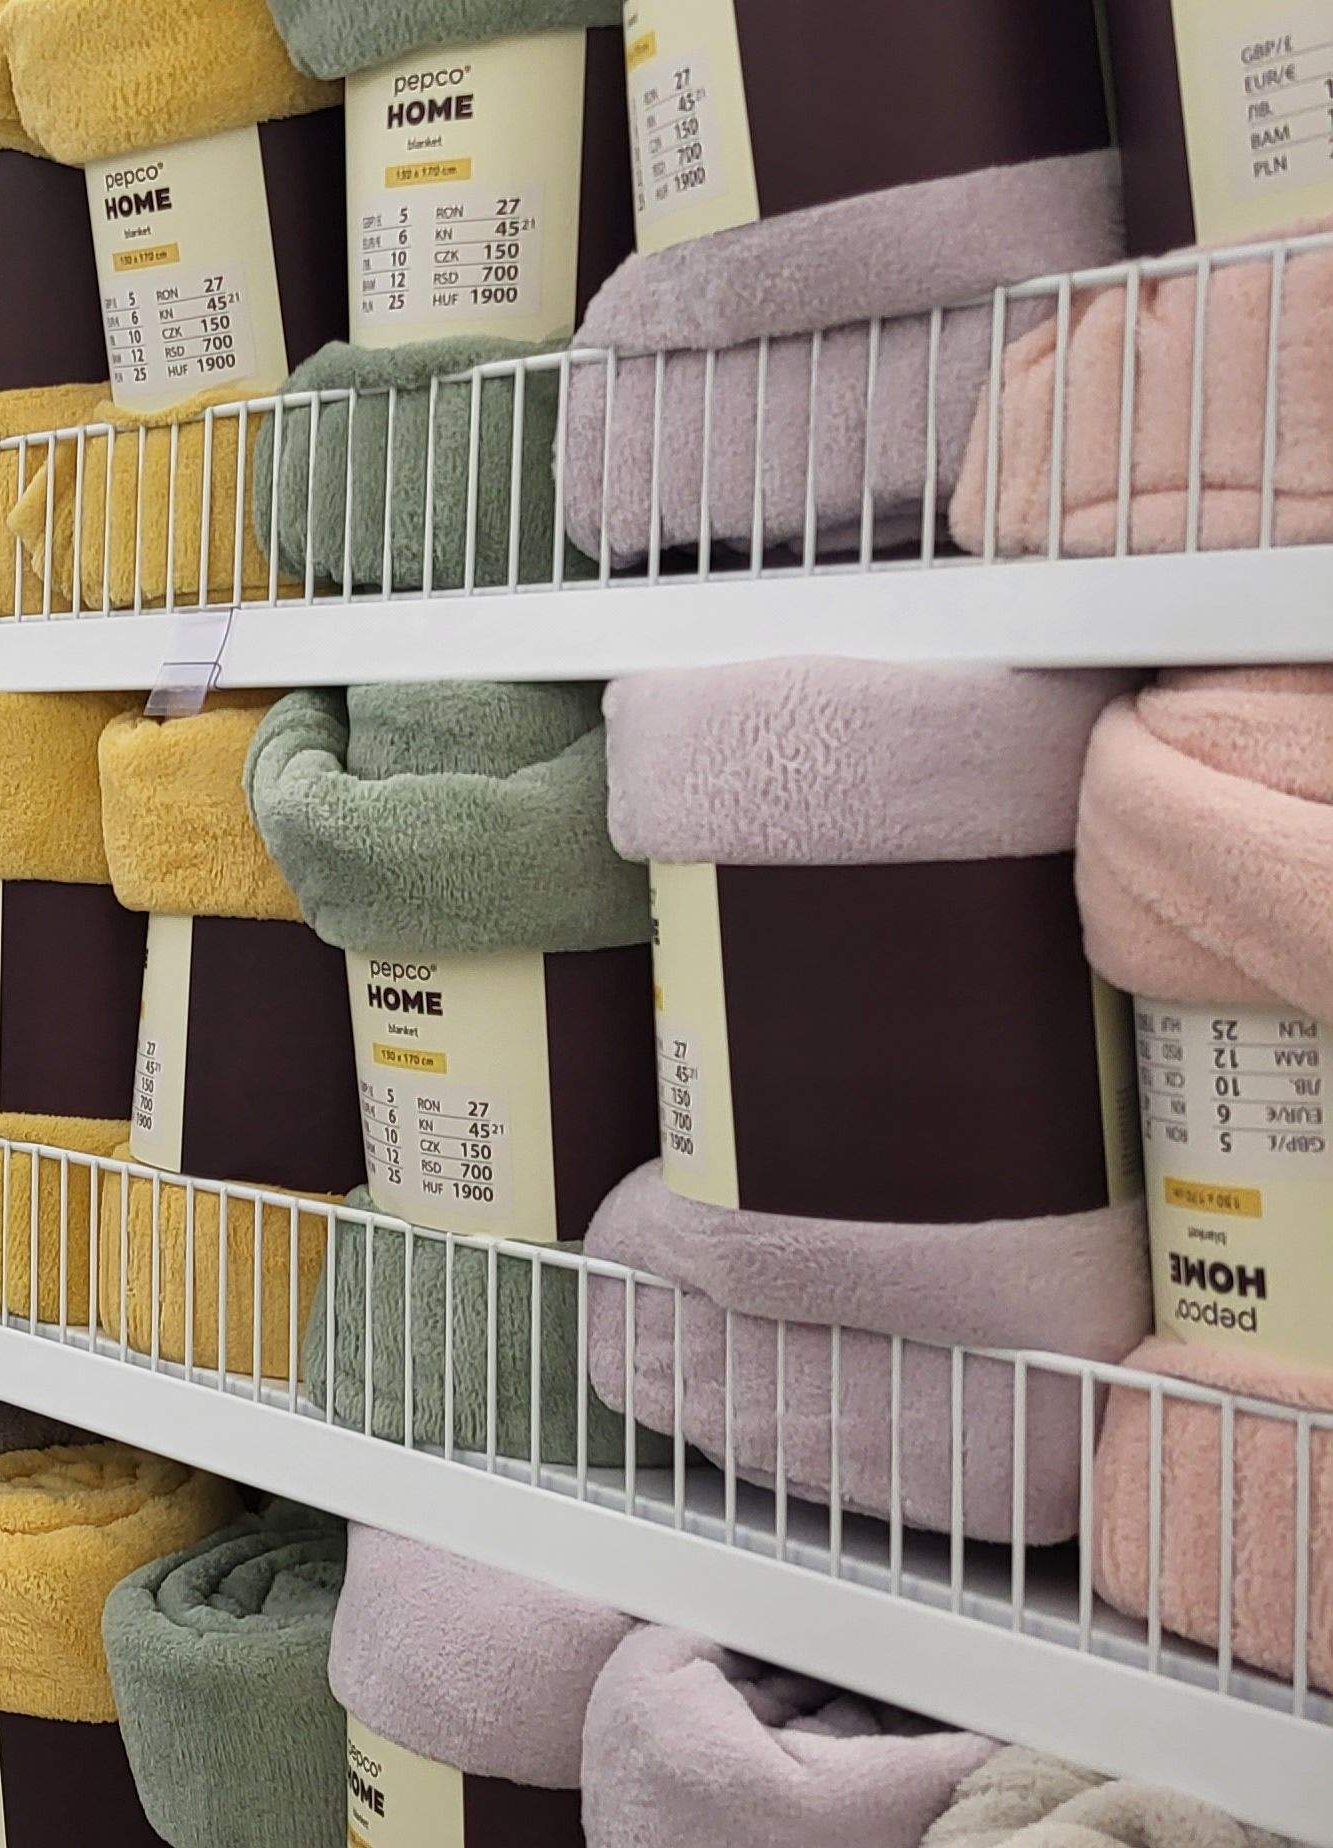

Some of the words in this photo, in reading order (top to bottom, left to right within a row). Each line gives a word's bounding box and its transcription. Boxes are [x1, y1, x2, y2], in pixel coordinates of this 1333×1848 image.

[387, 94, 474, 129] HOME
[1251, 125, 1290, 149] BAM
[1254, 156, 1287, 177] PLN
[105, 188, 172, 221] HOME
[436, 206, 463, 219] RON
[496, 199, 520, 215] 27
[399, 208, 408, 223] 5
[399, 229, 407, 244] 6
[435, 228, 453, 240] KN
[391, 251, 406, 266] 10
[435, 250, 459, 262] CZK
[484, 244, 519, 259] 150
[390, 274, 405, 287] 12
[434, 273, 459, 284] RSD
[483, 266, 518, 281] 700
[157, 288, 178, 300] RON
[204, 277, 224, 293] 27
[433, 295, 458, 306] HUF
[471, 288, 518, 304] 1900
[389, 295, 405, 310] 25
[160, 308, 173, 320] KN
[162, 327, 182, 339] CZK
[201, 315, 230, 333] 150
[129, 330, 141, 344] 10
[166, 346, 185, 357] RSD
[203, 335, 233, 352] 700
[131, 349, 144, 363] 12
[168, 365, 188, 377] HUF
[197, 354, 235, 373] 1900
[135, 368, 147, 382] 25
[367, 984, 443, 1016] HOME
[388, 1024, 418, 1037] blanket
[1212, 1020, 1238, 1041] 25
[1279, 1021, 1317, 1039] PLN
[422, 1058, 433, 1066] cm
[1214, 1047, 1239, 1068] 12
[1275, 1050, 1319, 1067] BAM
[1216, 1076, 1240, 1097] 10
[387, 1089, 394, 1103] 5
[389, 1109, 396, 1124] 6
[418, 1098, 440, 1112] RON
[468, 1102, 489, 1117] 27
[1217, 1105, 1230, 1122] 6
[419, 1119, 433, 1131] KN
[385, 1128, 397, 1144] 10
[1221, 1132, 1232, 1153] 5
[387, 1148, 399, 1164] 12
[420, 1141, 441, 1153] CZK
[461, 1143, 491, 1160] 150
[388, 1167, 401, 1184] 25
[422, 1161, 442, 1174] RSD
[461, 1164, 492, 1181] 700
[423, 1181, 443, 1194] HUF
[453, 1183, 493, 1202] 1900
[1169, 1252, 1267, 1299] HOME
